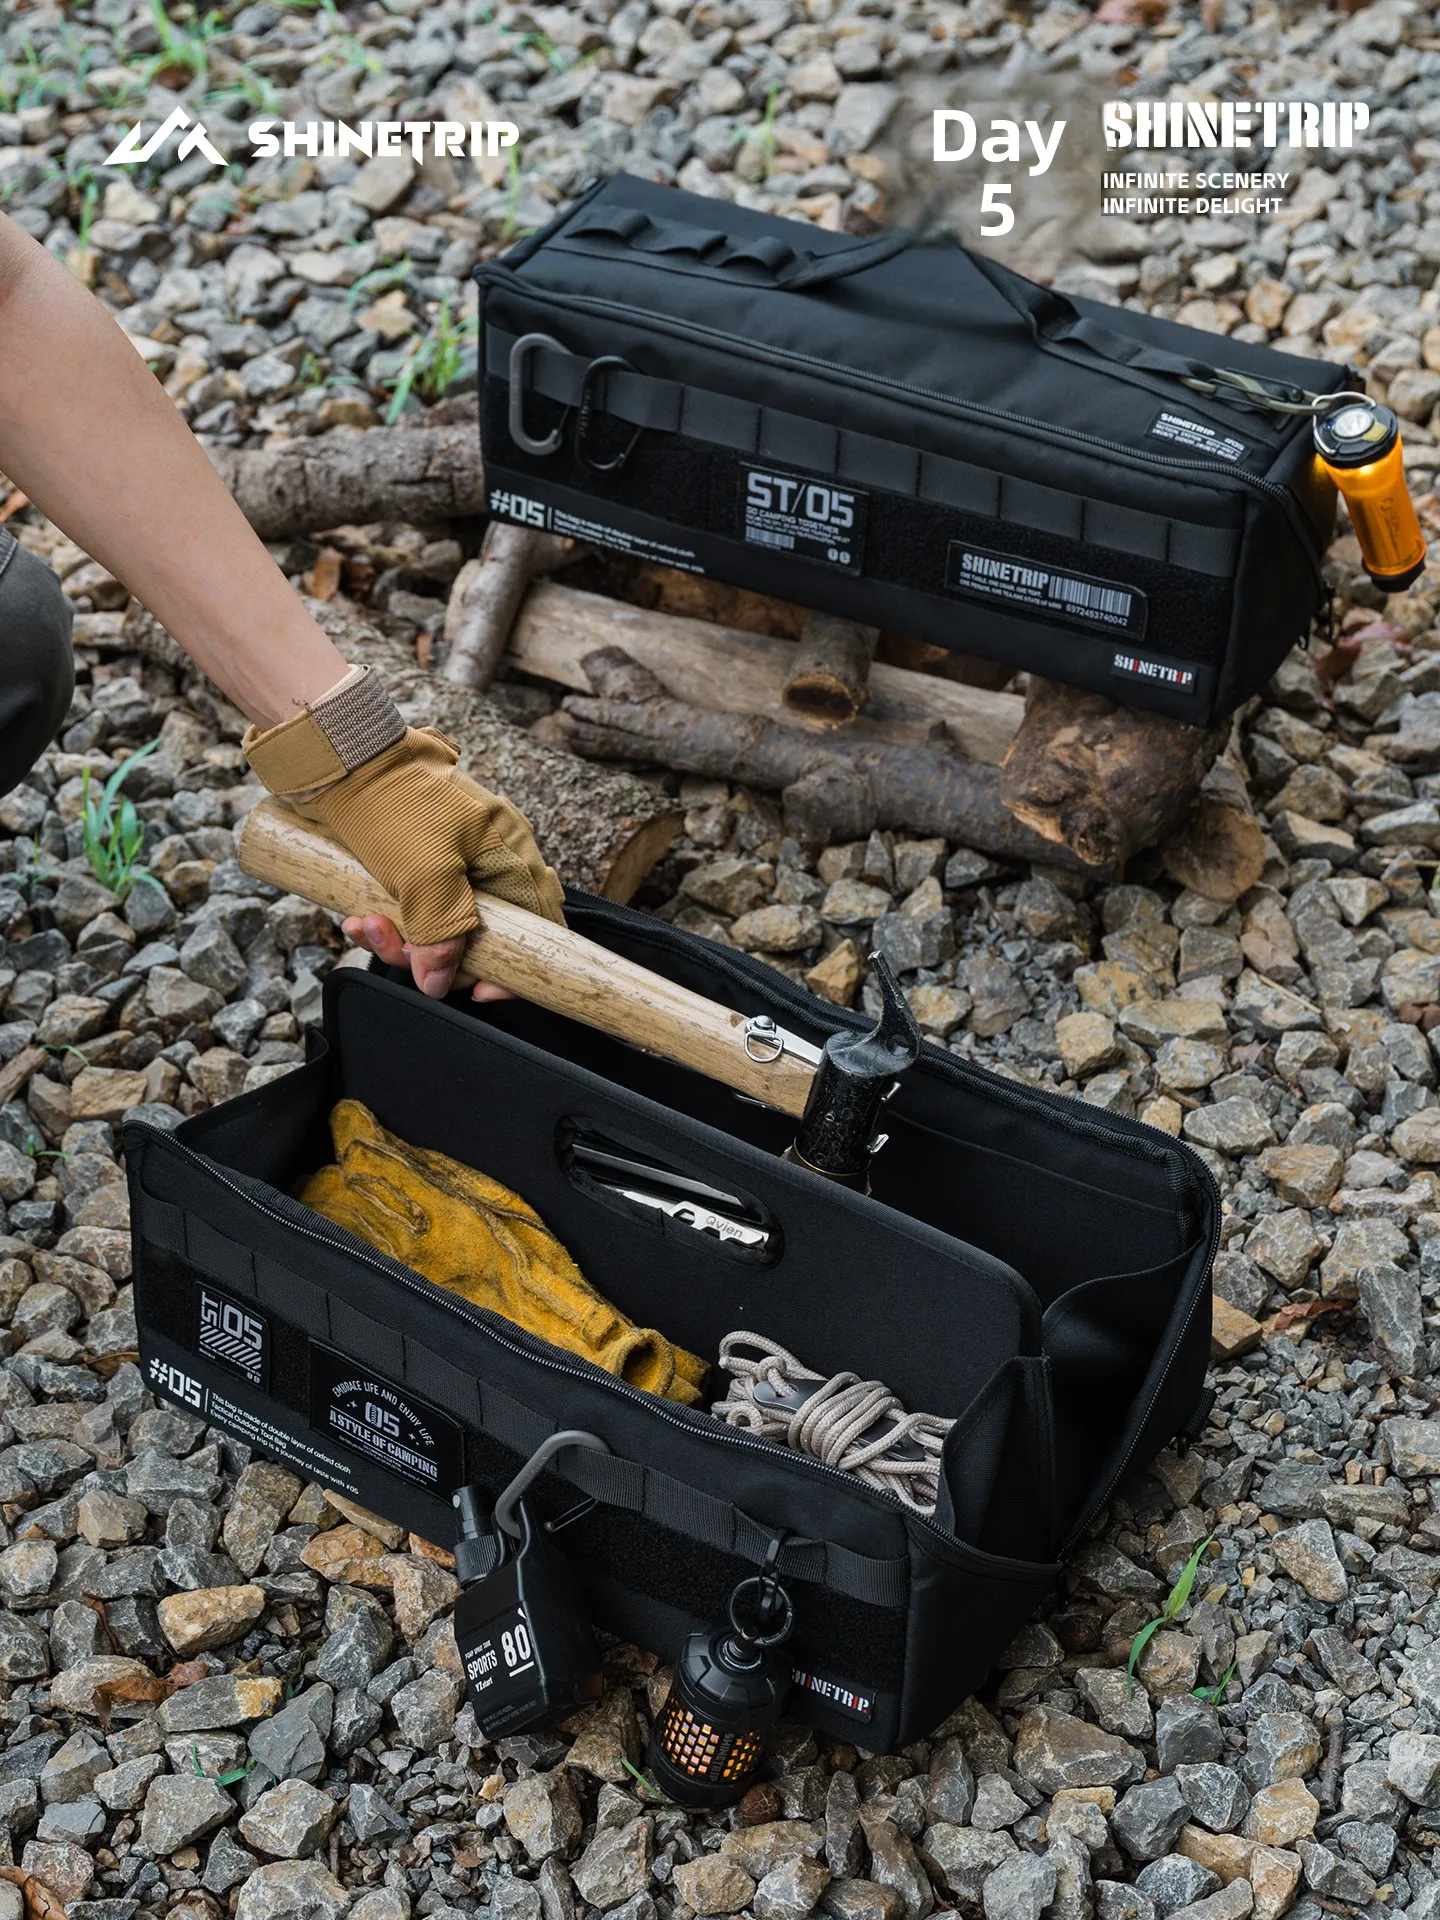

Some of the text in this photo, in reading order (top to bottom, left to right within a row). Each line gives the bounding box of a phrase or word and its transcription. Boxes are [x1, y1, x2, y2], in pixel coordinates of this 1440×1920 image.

[490, 489, 545, 528] #05
[962, 552, 1049, 589] SHINETRIP
[705, 1214, 744, 1239] Qvien
[149, 1358, 202, 1408] #05
[211, 1401, 234, 1419] Tactical
[234, 1414, 259, 1433] Outdoor
[274, 1437, 287, 1449] Bag
[332, 1380, 435, 1446] EMBRACE LIFE AND ENJOY LIFE
[365, 1401, 400, 1438] 05
[210, 1409, 228, 1424] Every
[228, 1420, 256, 1440] camping
[256, 1435, 268, 1446] trip
[268, 1442, 275, 1450] is
[280, 1449, 305, 1467] journey
[313, 1467, 330, 1479] taste
[330, 1476, 345, 1487] with
[225, 1400, 237, 1413] bag
[237, 1407, 243, 1416] is
[243, 1412, 261, 1425] made
[268, 1426, 290, 1442] double
[290, 1437, 306, 1450] layer
[314, 1451, 334, 1465] oxford
[334, 1462, 351, 1474] cloth
[337, 1414, 371, 1442] STYLE
[372, 1434, 387, 1449] OF
[387, 1442, 438, 1478] CAMPING
[467, 1649, 498, 1681] SPORTS
[501, 1623, 532, 1668] 80
